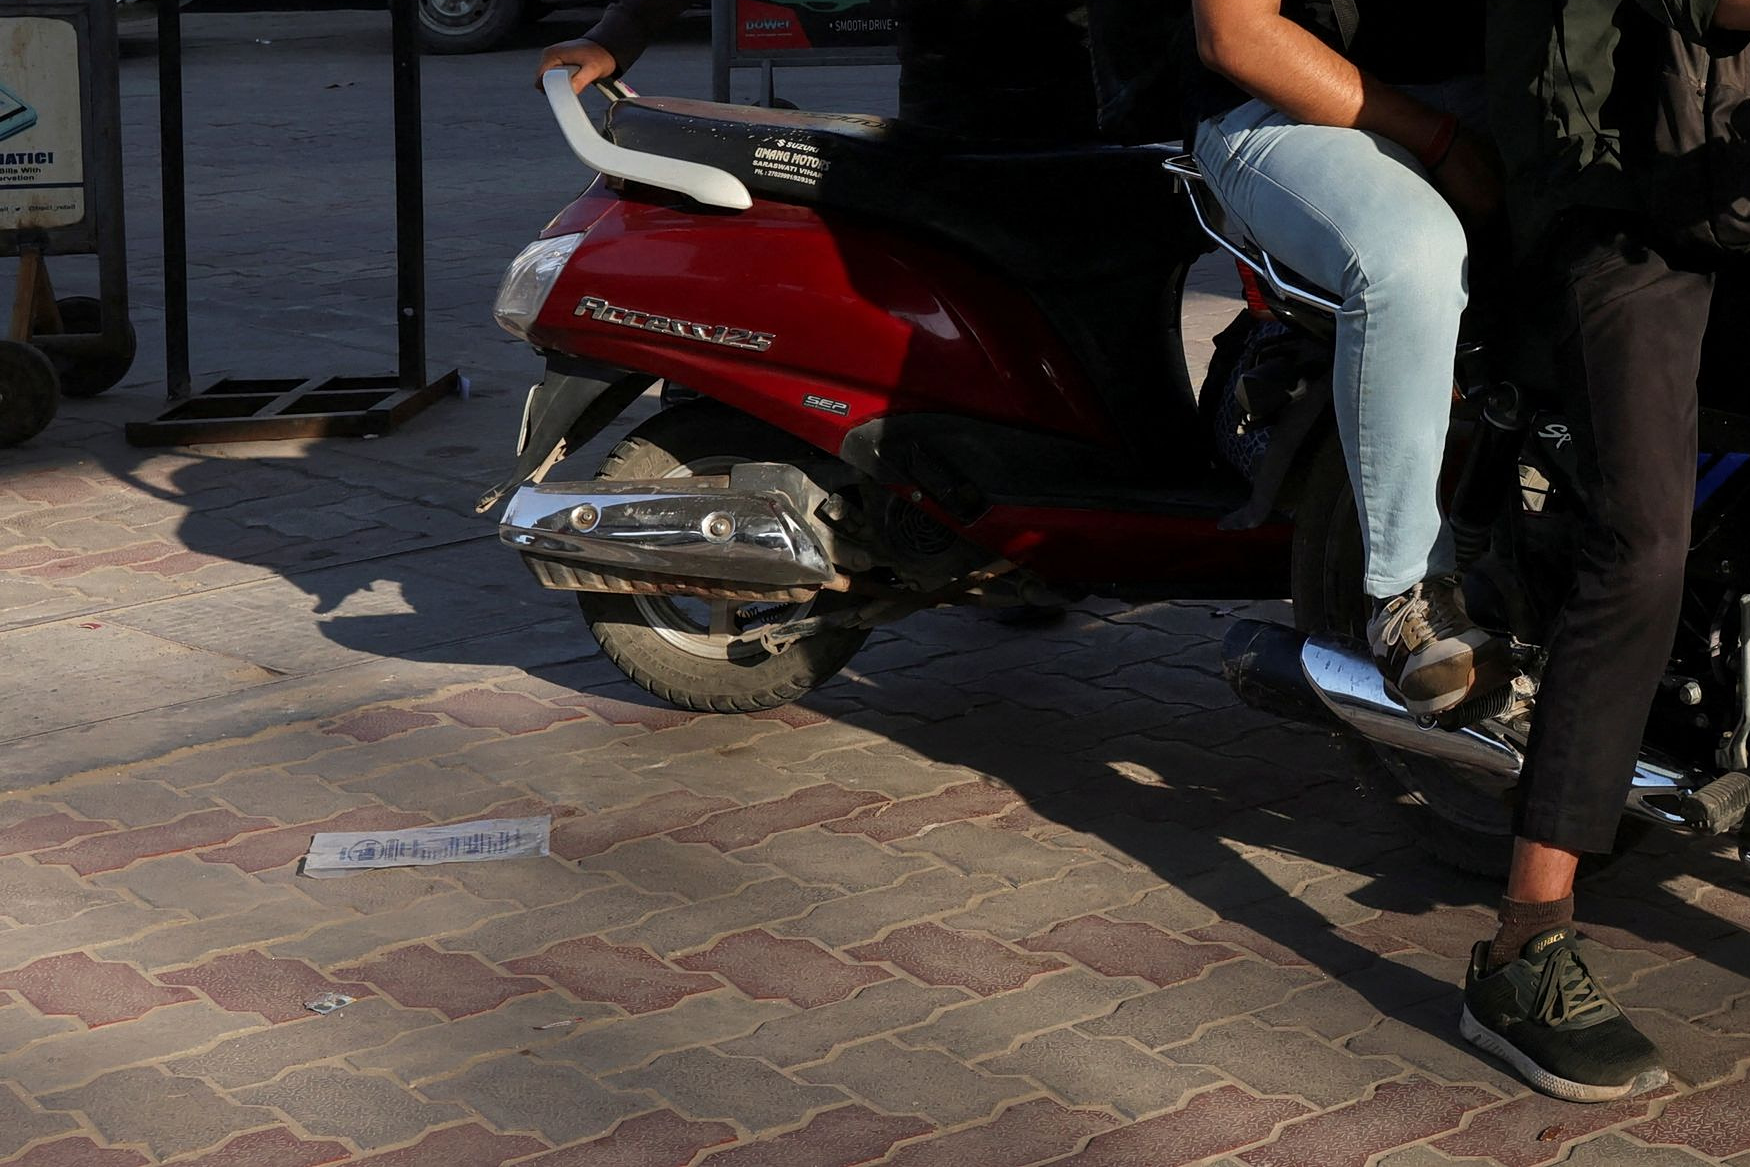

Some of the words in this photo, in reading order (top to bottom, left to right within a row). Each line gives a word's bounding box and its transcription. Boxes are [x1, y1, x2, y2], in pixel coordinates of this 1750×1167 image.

[834, 19, 868, 32] SMOOTH
[868, 18, 893, 31] DRIVE
[785, 141, 820, 154] SUZUKI
[754, 147, 791, 163] UMANG
[791, 152, 832, 172] MOTORS
[752, 159, 798, 173] SARASWATI
[799, 167, 824, 179] VIHAR
[805, 395, 848, 410] SEP
